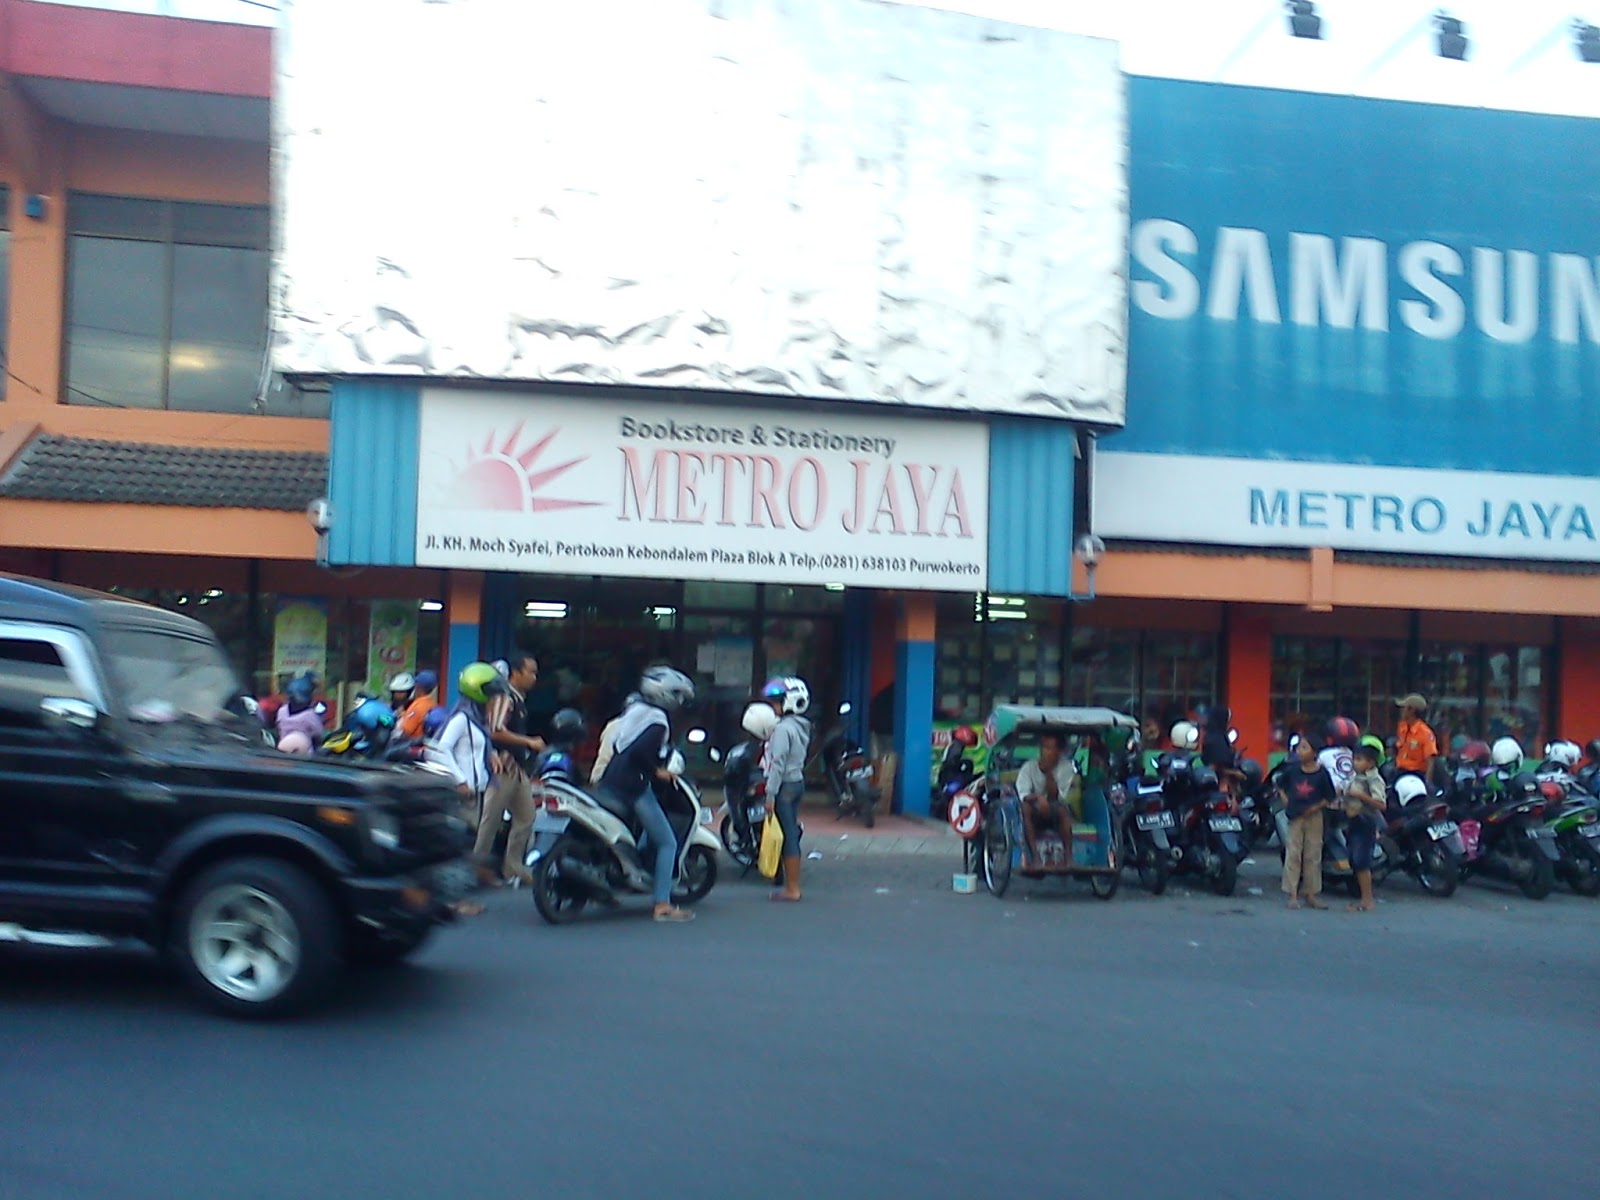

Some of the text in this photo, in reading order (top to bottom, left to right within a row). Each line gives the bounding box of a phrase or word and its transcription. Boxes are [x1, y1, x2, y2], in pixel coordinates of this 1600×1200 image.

[621, 415, 896, 459] Bookstore & Stationery
[616, 446, 974, 539] METRO JAYA
[1249, 487, 1598, 541] METRO JAYA
[425, 535, 440, 550] Jl.
[443, 535, 467, 551] KH.
[469, 536, 505, 553] Moch
[556, 541, 624, 559] Pertokoan
[627, 544, 709, 564] Kebondalem
[711, 548, 745, 565] Plaza
[748, 551, 776, 566] Blok
[778, 553, 788, 567] A
[861, 555, 907, 572] 638103
[909, 558, 981, 576] Purwokerto
